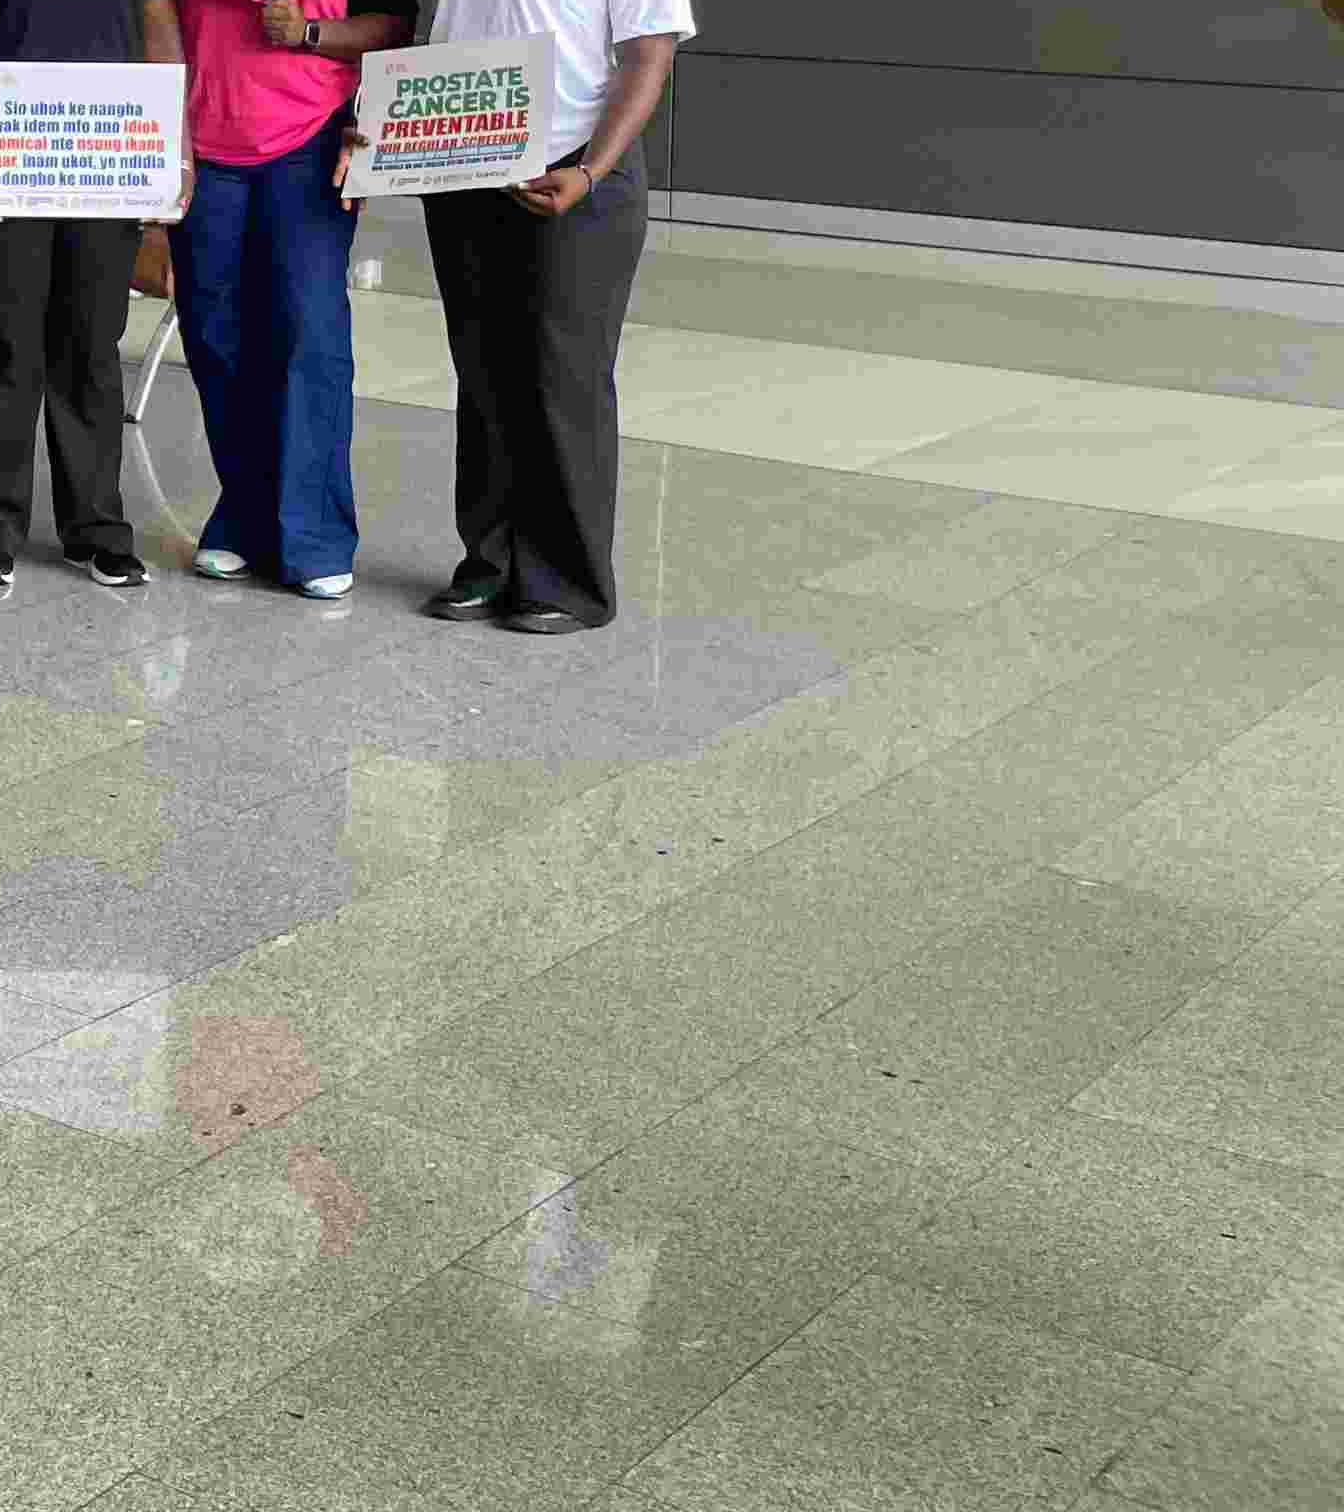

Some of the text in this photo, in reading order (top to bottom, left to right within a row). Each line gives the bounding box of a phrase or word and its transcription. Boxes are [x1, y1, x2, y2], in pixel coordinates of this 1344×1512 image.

[396, 66, 523, 98] PROSTATE
[388, 86, 530, 119] CANCER IS
[382, 110, 529, 139] PREVENTABLE
